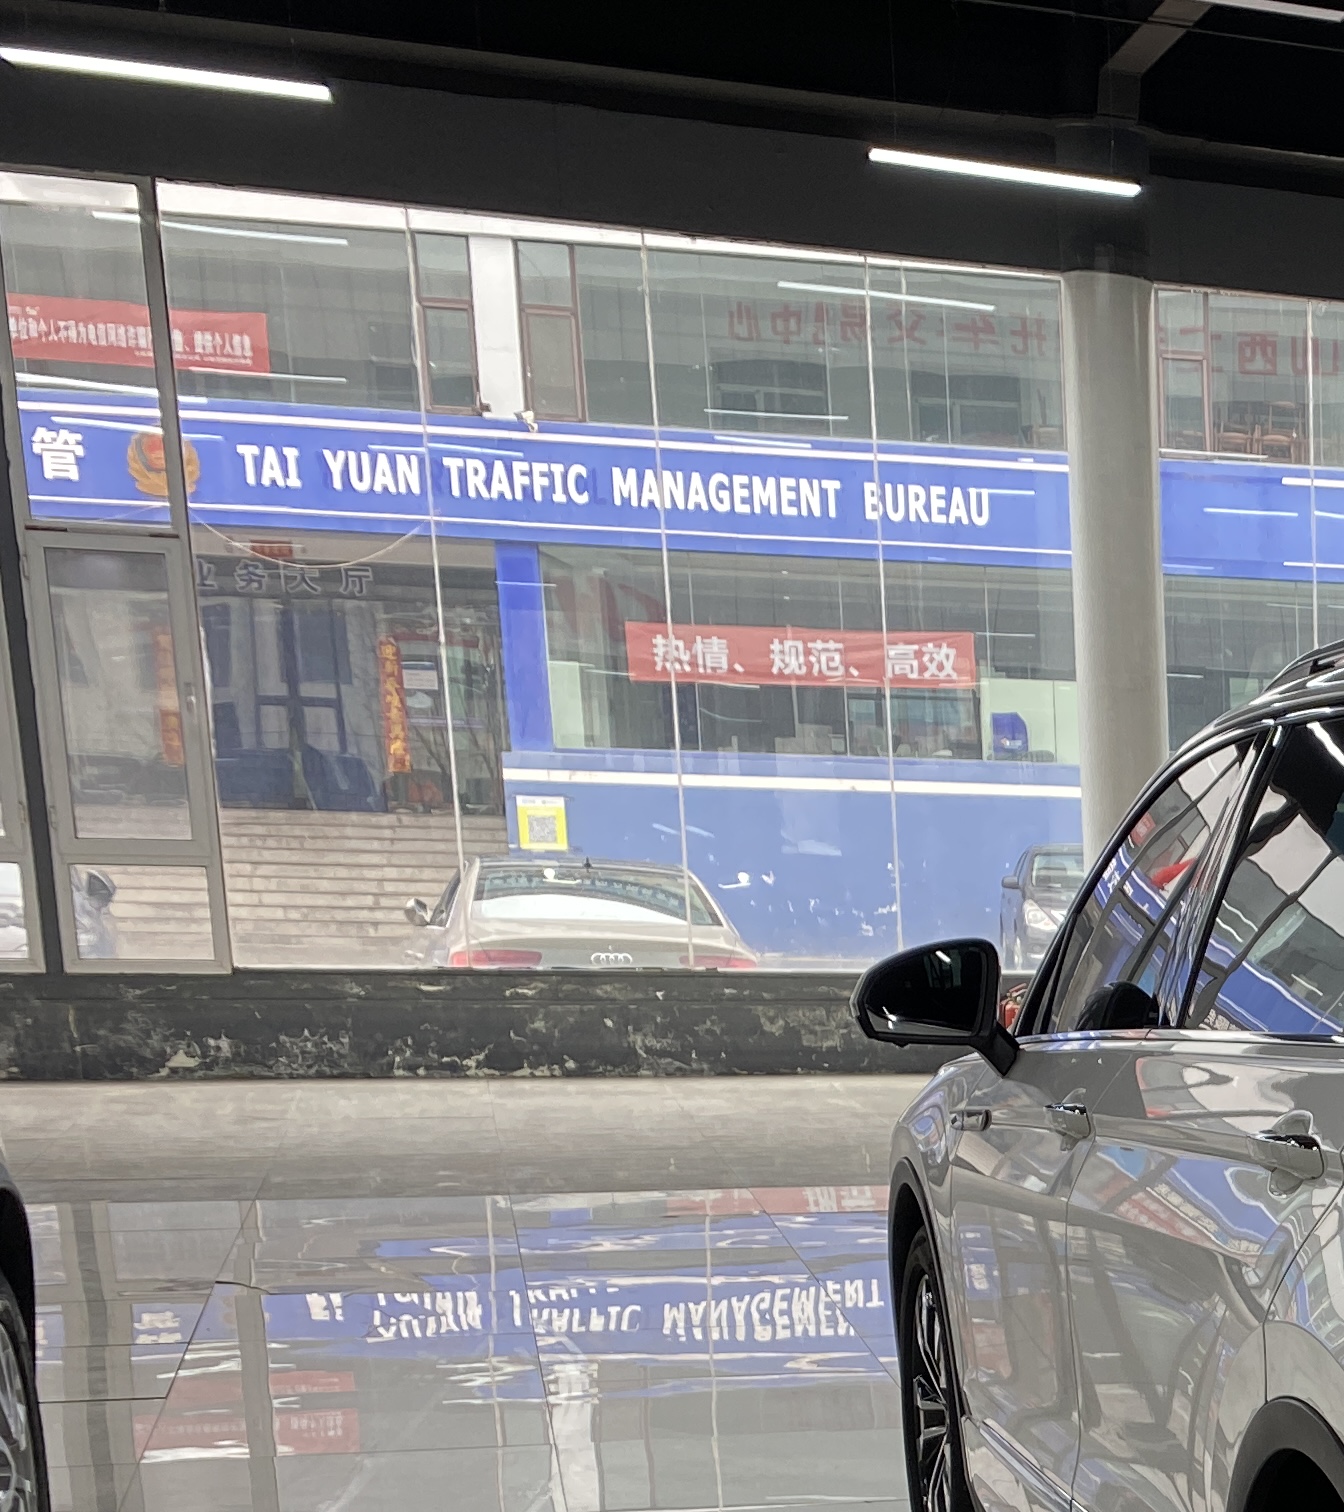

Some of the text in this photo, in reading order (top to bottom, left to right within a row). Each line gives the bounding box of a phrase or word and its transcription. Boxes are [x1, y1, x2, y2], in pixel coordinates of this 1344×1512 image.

[31, 427, 86, 483] 管
[236, 444, 990, 526] TAI YUAN TRAFFIC MANAGEMENT BUREAU
